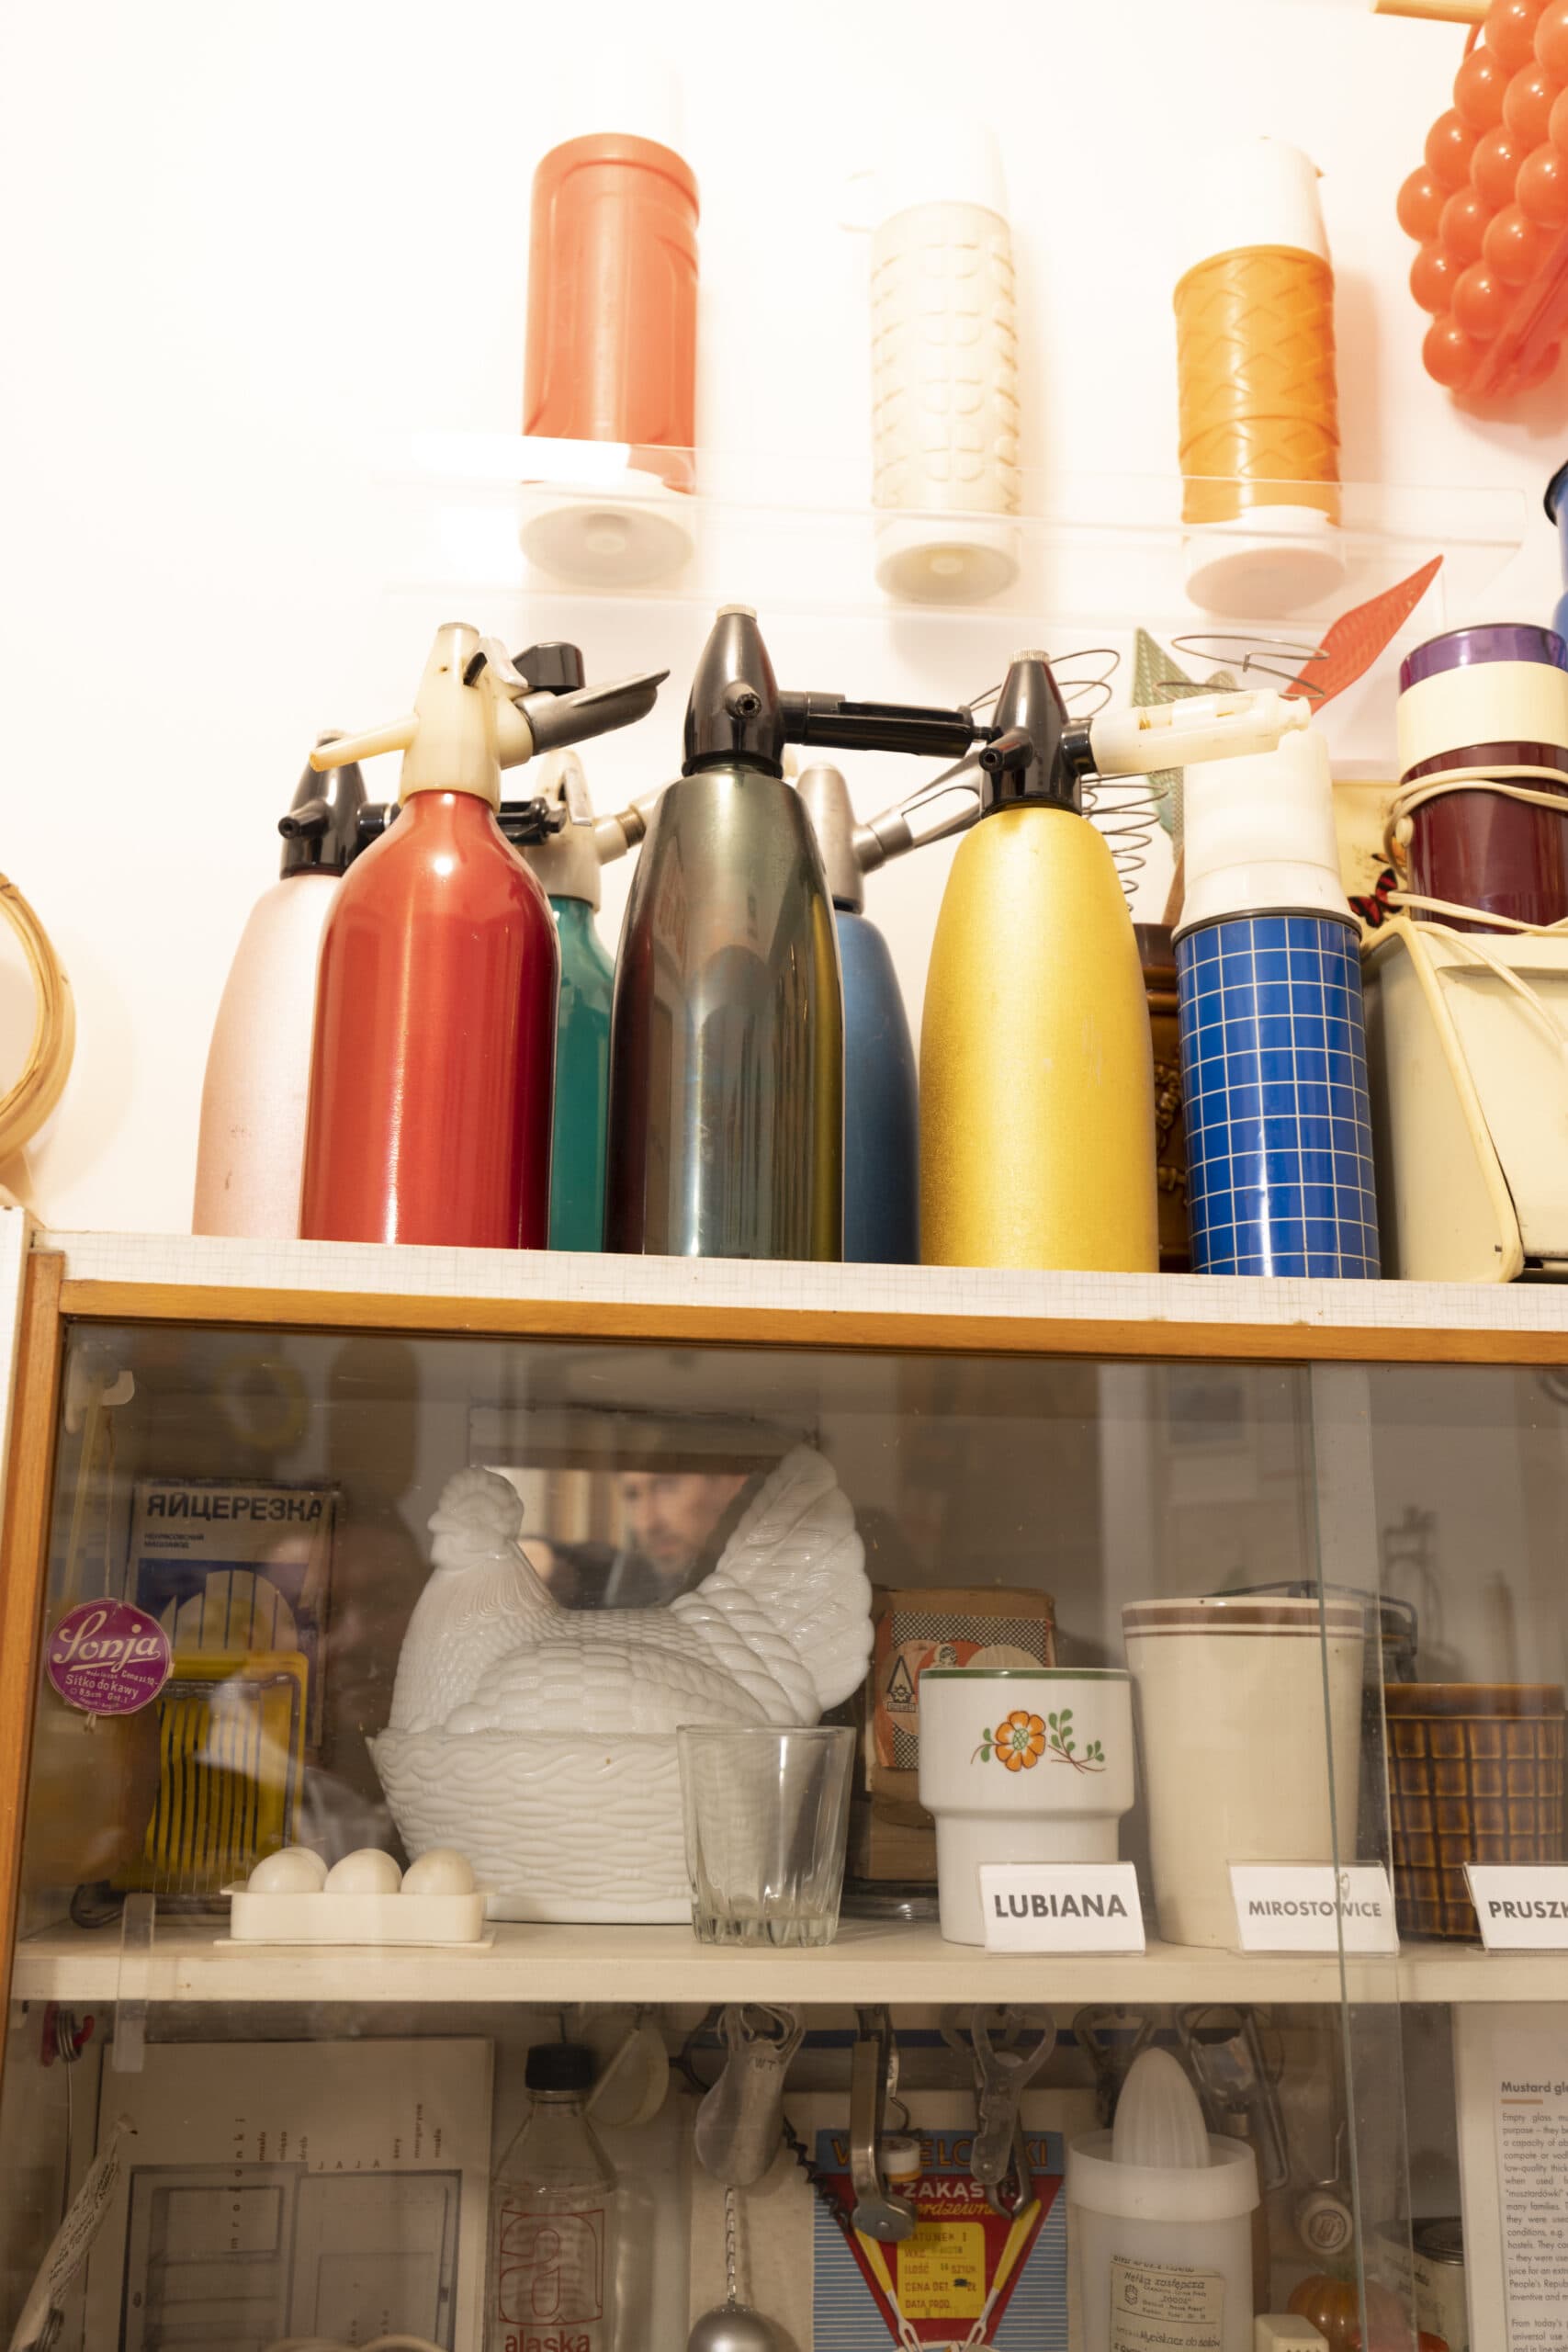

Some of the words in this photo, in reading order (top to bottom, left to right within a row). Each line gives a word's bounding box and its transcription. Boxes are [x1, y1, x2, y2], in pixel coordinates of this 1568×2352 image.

[52, 1610, 162, 1673] Sonja
[65, 1674, 96, 1690] Sitko
[96, 1679, 109, 1690] do
[110, 1680, 139, 1700] kawy
[994, 1894, 1128, 1917] LUBIANA
[1248, 1901, 1382, 1917] MIROSTOWICE
[1501, 2081, 1551, 2093] Mustard
[1503, 2112, 1526, 2123] Empty
[1532, 2111, 1551, 2123] glass
[1512, 2139, 1544, 2150] capacity
[1506, 2176, 1526, 2185] when
[1536, 2176, 1554, 2185] used
[1537, 2240, 1555, 2251] They
[1516, 2252, 1532, 2264] they
[905, 2282, 931, 2291] CENA
[1545, 2292, 1560, 2301] and
[905, 2300, 926, 2309] DATA
[504, 2328, 592, 2352] alaska
